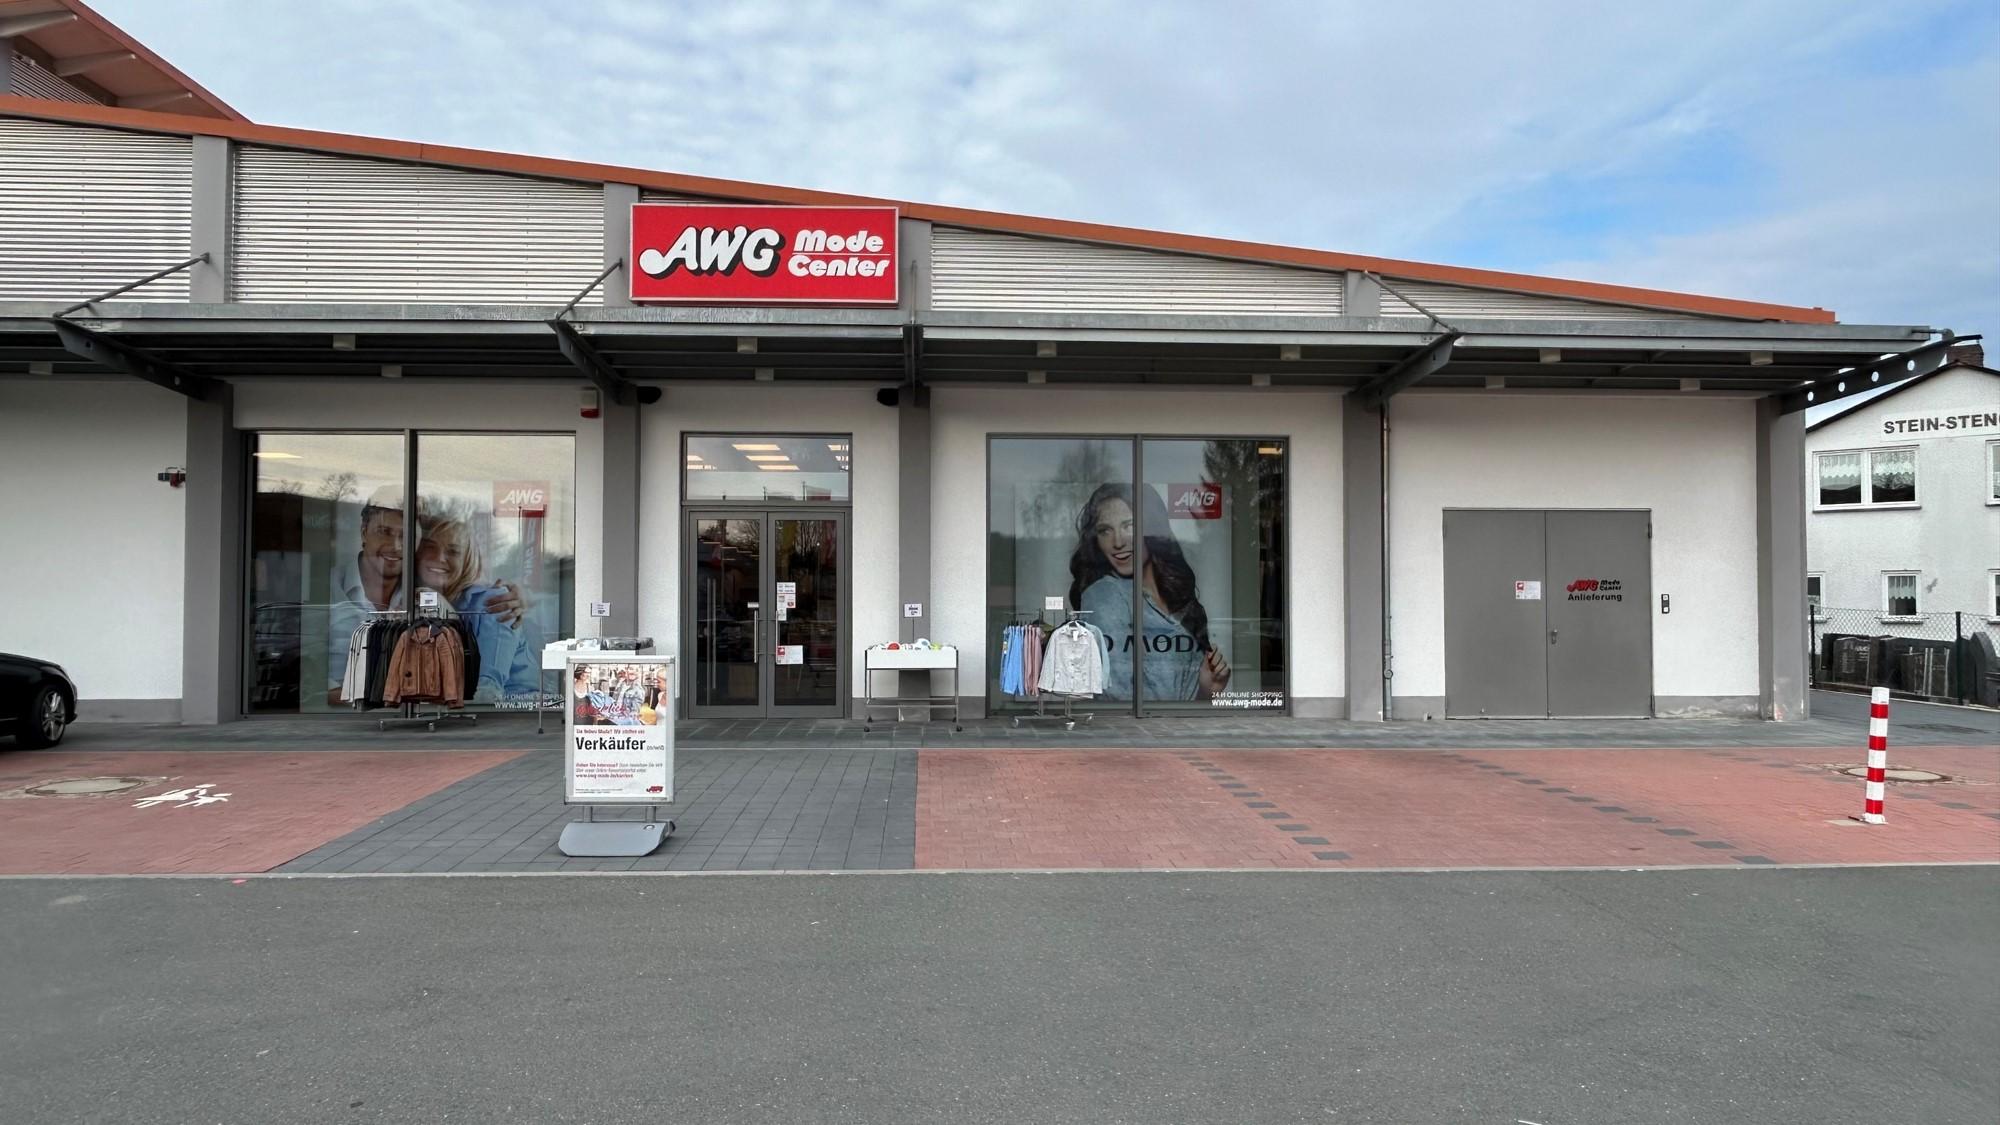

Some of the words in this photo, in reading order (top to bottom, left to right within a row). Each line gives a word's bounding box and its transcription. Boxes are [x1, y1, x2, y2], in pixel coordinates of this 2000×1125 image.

[793, 229, 885, 253] Mode
[639, 225, 786, 280] AWG
[787, 254, 891, 278] Center
[1883, 412, 2000, 434] STEIN-STEN
[500, 488, 544, 505] AWG
[1174, 490, 1217, 507] AWG
[1567, 593, 1623, 602] Anlieferung
[1211, 697, 1283, 709] www.awg-mode.de
[575, 736, 646, 751] Verkäufer
